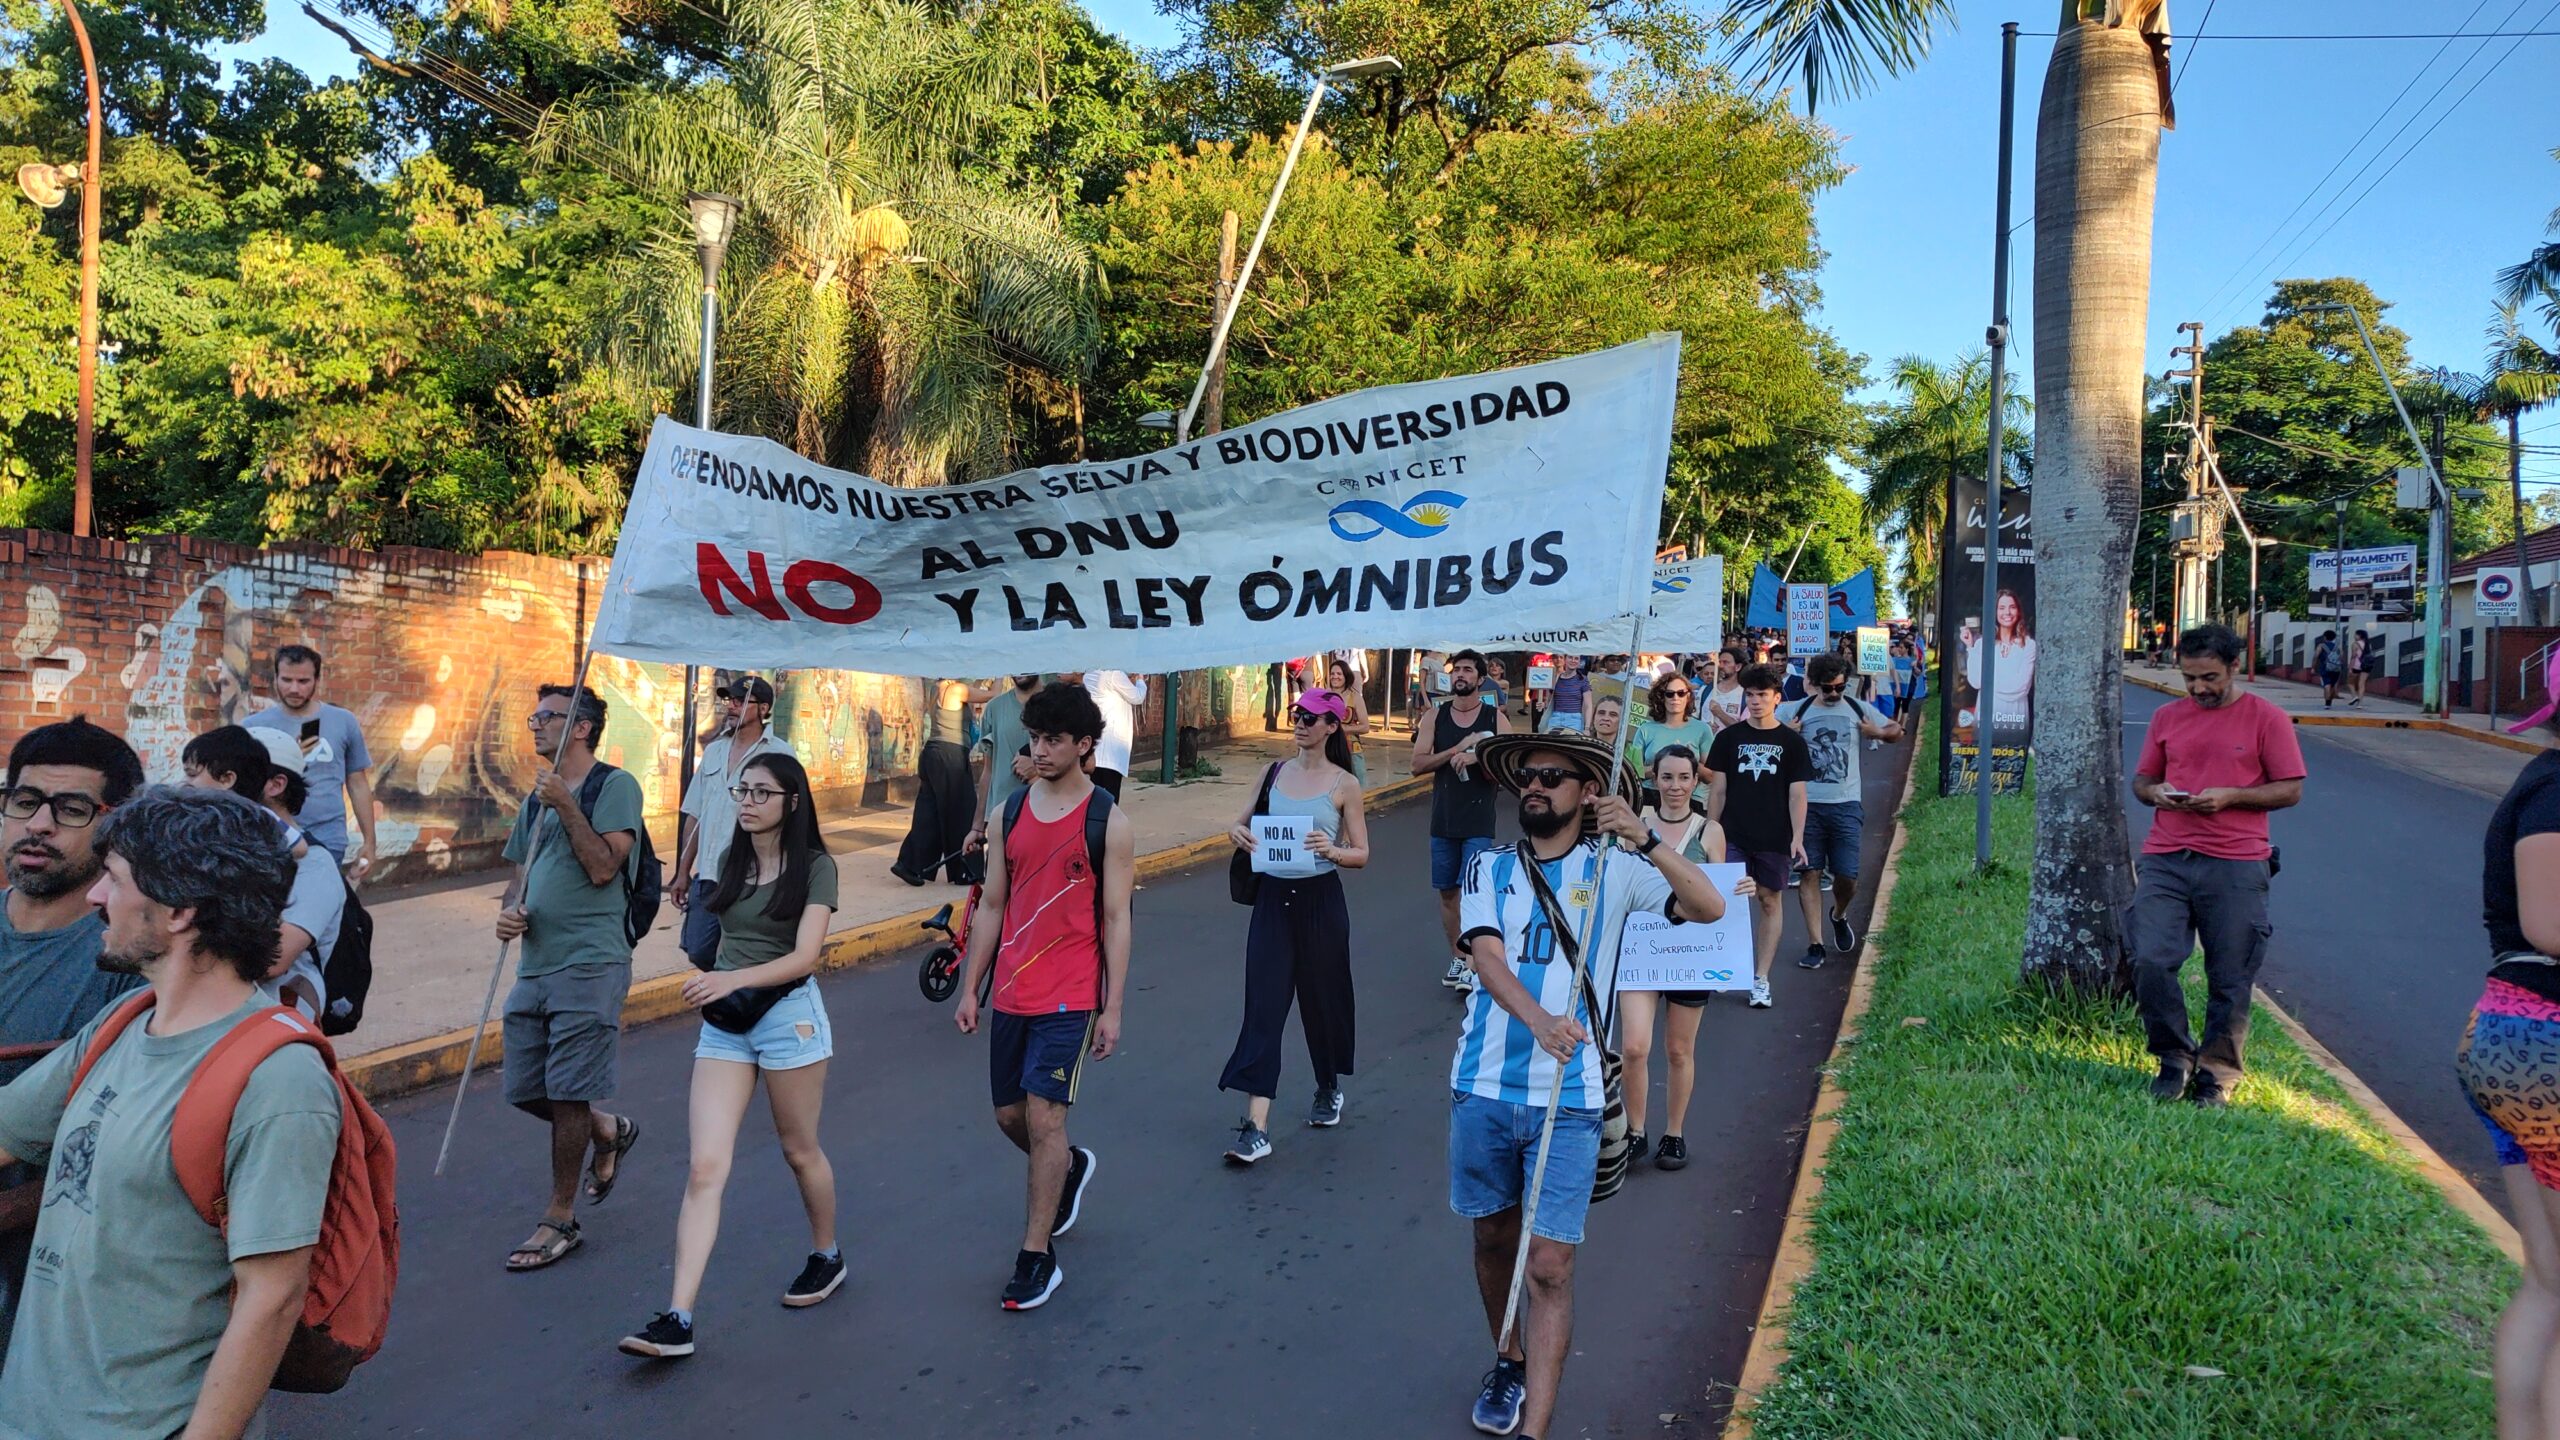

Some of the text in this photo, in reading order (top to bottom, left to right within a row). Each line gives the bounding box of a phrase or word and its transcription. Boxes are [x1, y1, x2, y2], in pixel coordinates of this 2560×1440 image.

[670, 381, 1571, 522] DEFENDAMOS NUESTRA SELVA Y BIODIVERSIDAD
[921, 509, 1180, 580] AL DNU
[2315, 552, 2409, 569] PRÓXIMAMENTE
[1653, 565, 1691, 577] NICET
[696, 542, 883, 625] NO
[935, 530, 1569, 634] Y LA LEY ÓMNIBUS
[1801, 588, 1824, 599] SALUD
[1798, 600, 1808, 610] ES
[1809, 600, 1820, 610] UN
[1791, 610, 1824, 621] DERECHO
[1809, 622, 1820, 630] UN
[1522, 630, 1589, 643] CULTURA
[1995, 711, 2025, 723] Center
[1738, 744, 1783, 760] THRASHER
[1264, 826, 1296, 840] NO AL
[1268, 847, 1292, 862] DNU
[1517, 922, 1556, 965] 10
[1624, 942, 1638, 956] RÁ
[1647, 968, 1659, 982] EN
[1665, 968, 1696, 982] LUCHA
